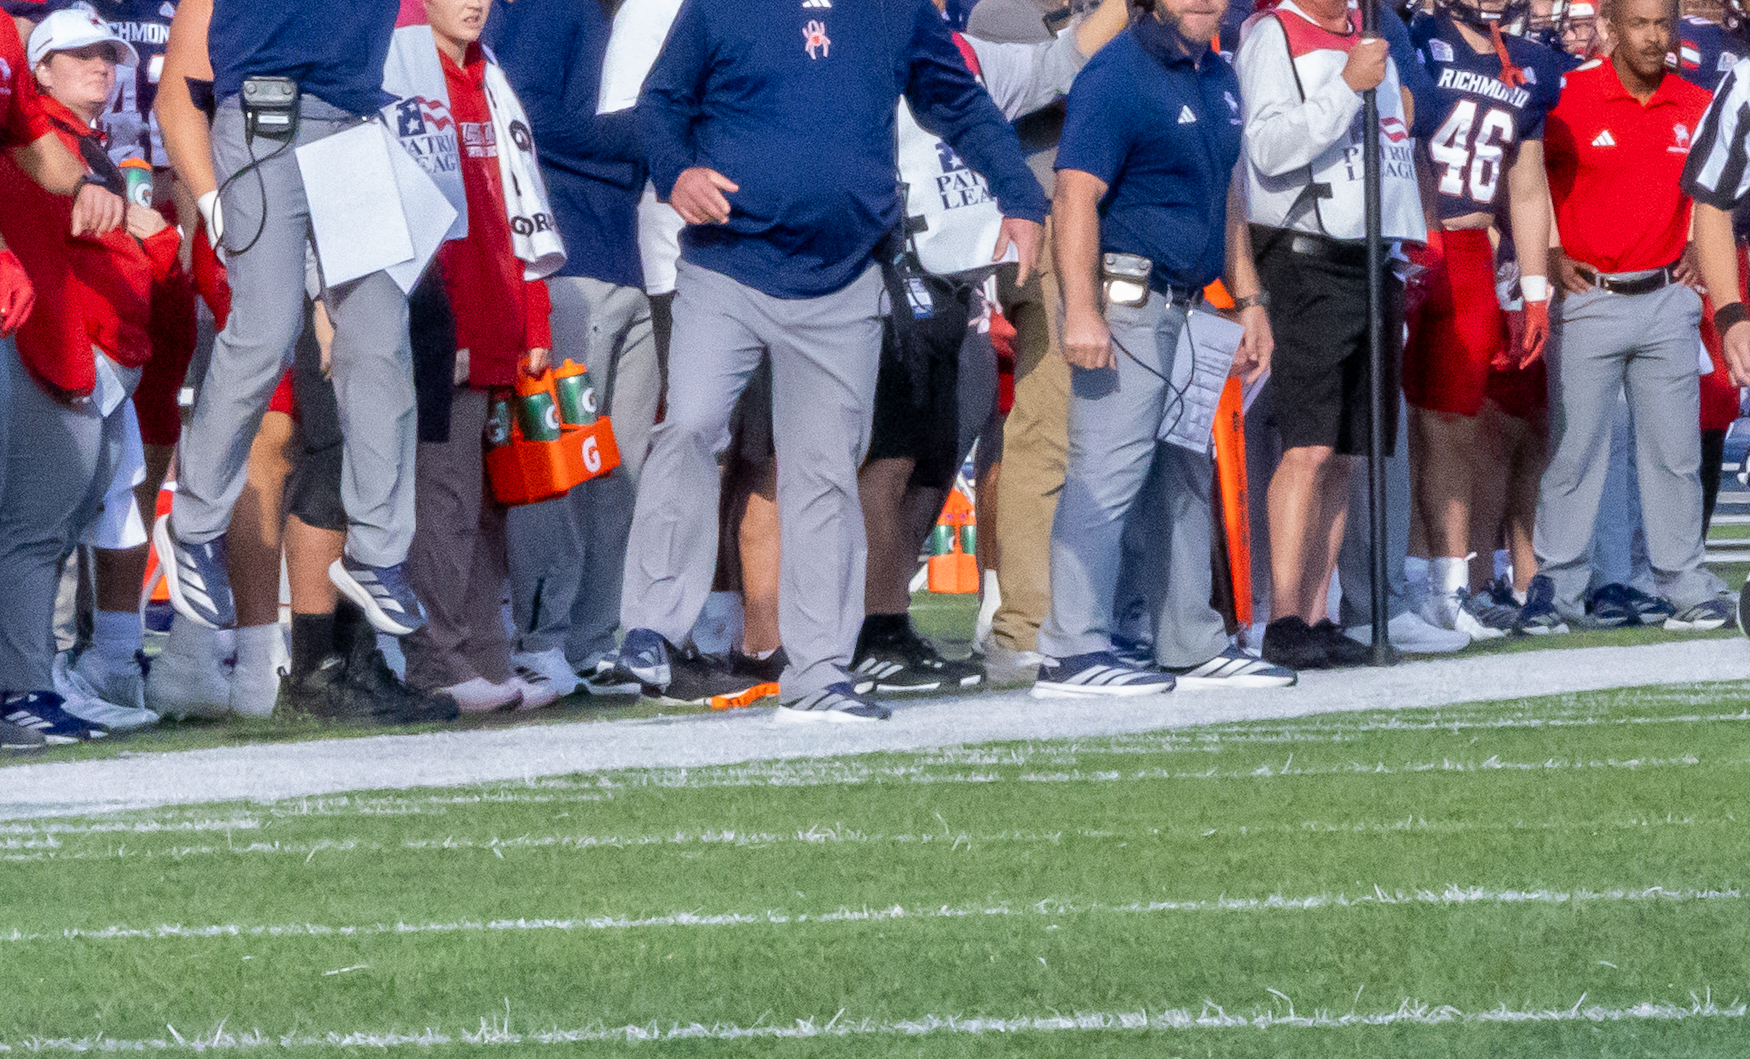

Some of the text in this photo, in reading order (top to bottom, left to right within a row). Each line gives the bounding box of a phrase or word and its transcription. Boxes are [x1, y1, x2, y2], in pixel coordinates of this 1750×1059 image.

[109, 23, 170, 45] CHMON
[1430, 99, 1514, 204] 46
[581, 435, 602, 473] G
